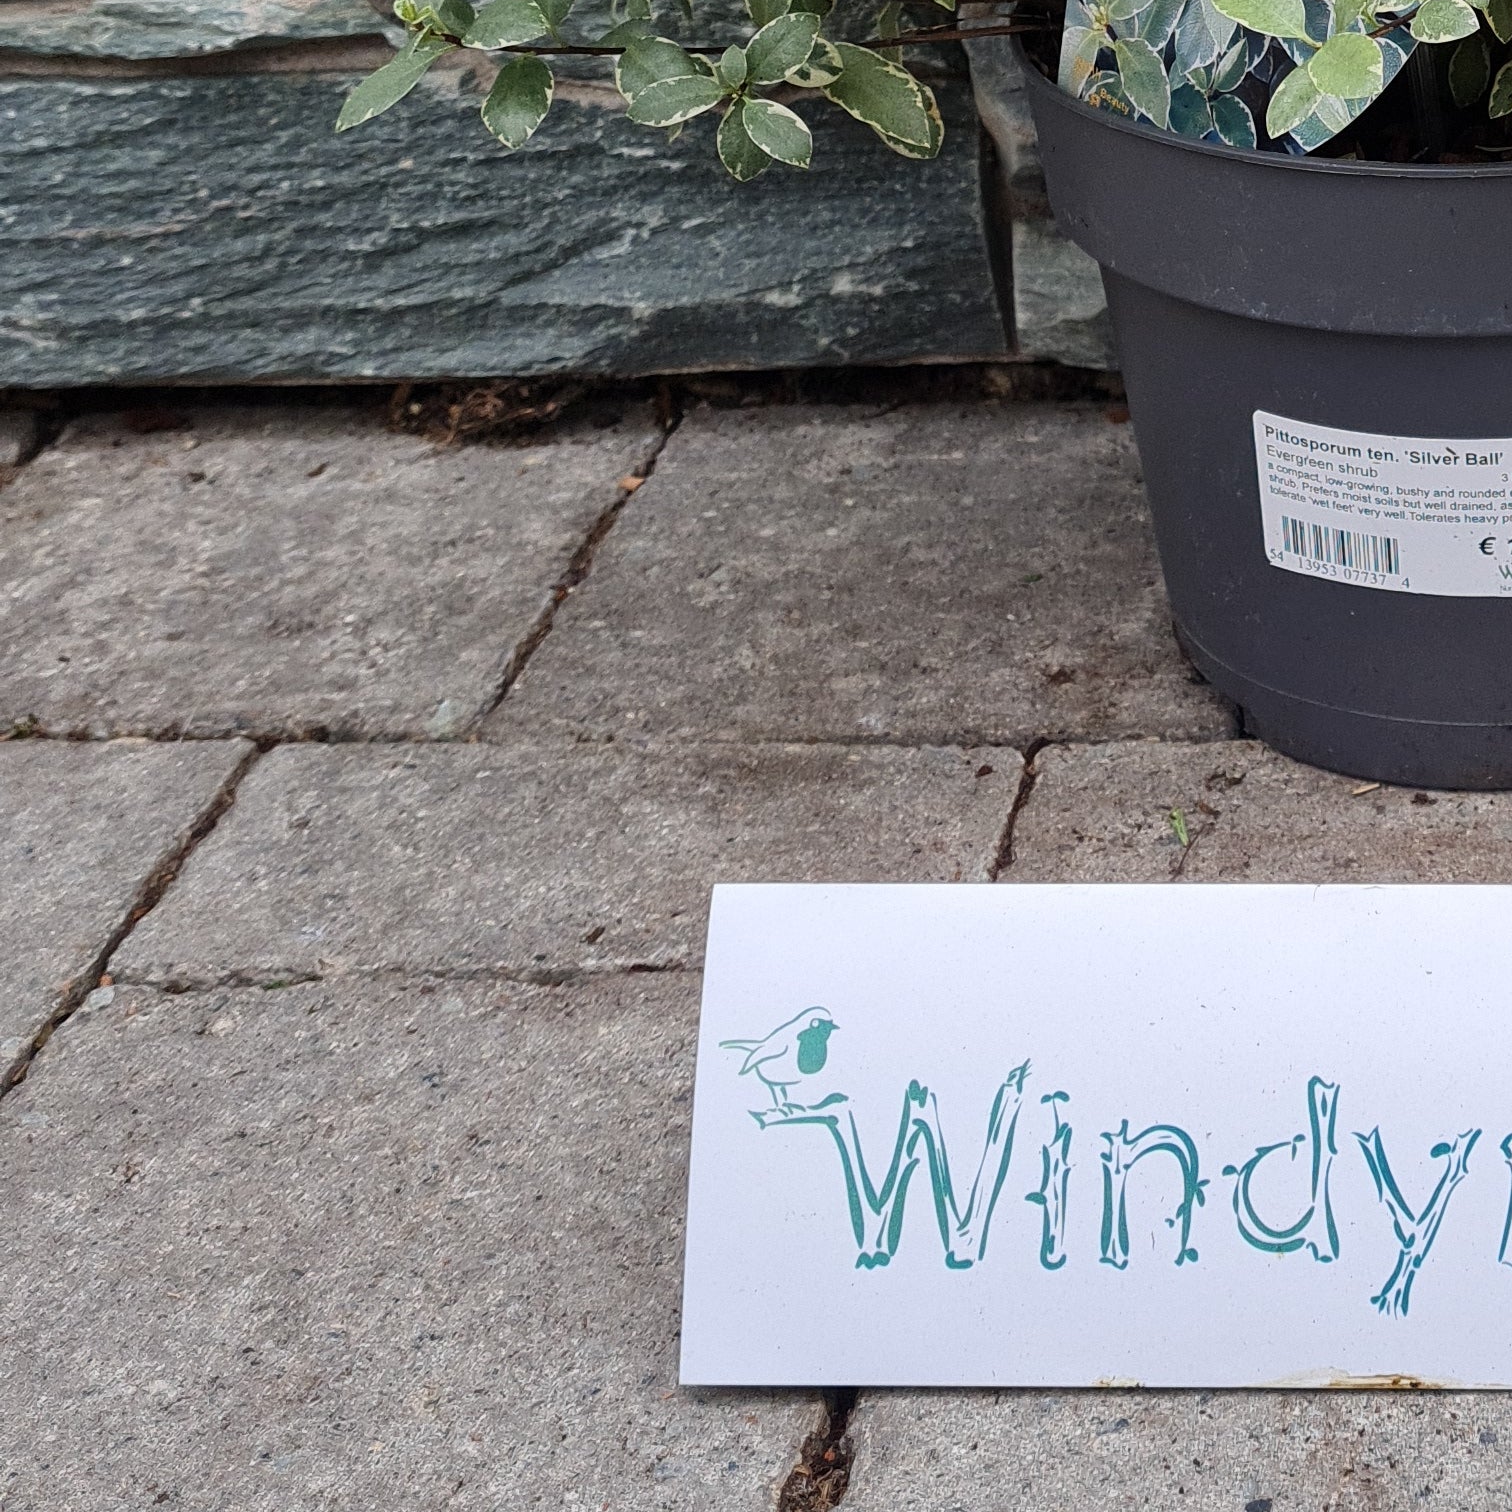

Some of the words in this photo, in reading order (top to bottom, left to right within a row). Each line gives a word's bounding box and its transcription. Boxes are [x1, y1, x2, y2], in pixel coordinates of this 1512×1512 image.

[1265, 424, 1362, 458] Pittosporum
[1367, 447, 1400, 463] ten.
[1404, 450, 1460, 466] 'Silver
[1465, 451, 1503, 466] Ball'
[1266, 444, 1334, 472] Evergreen
[1338, 463, 1379, 479] shrub
[1267, 462, 1274, 470] a
[1396, 485, 1431, 499] bushy
[1433, 488, 1456, 498] and
[1458, 488, 1506, 499] rounded
[1501, 473, 1509, 482] 3
[1269, 484, 1307, 503] tolerate
[1358, 506, 1381, 519] very
[1409, 510, 1461, 524] Tolerates
[1464, 513, 1499, 525] heavy
[1302, 481, 1340, 499] Prefers
[1342, 491, 1372, 504] moist
[1374, 496, 1400, 508] soils
[1403, 498, 1422, 509] but
[1424, 500, 1447, 511] well
[1478, 536, 1497, 556] €
[1270, 548, 1285, 563] 54
[1298, 556, 1338, 577] 13953
[1343, 569, 1387, 587] 07737
[1401, 577, 1411, 589] 4
